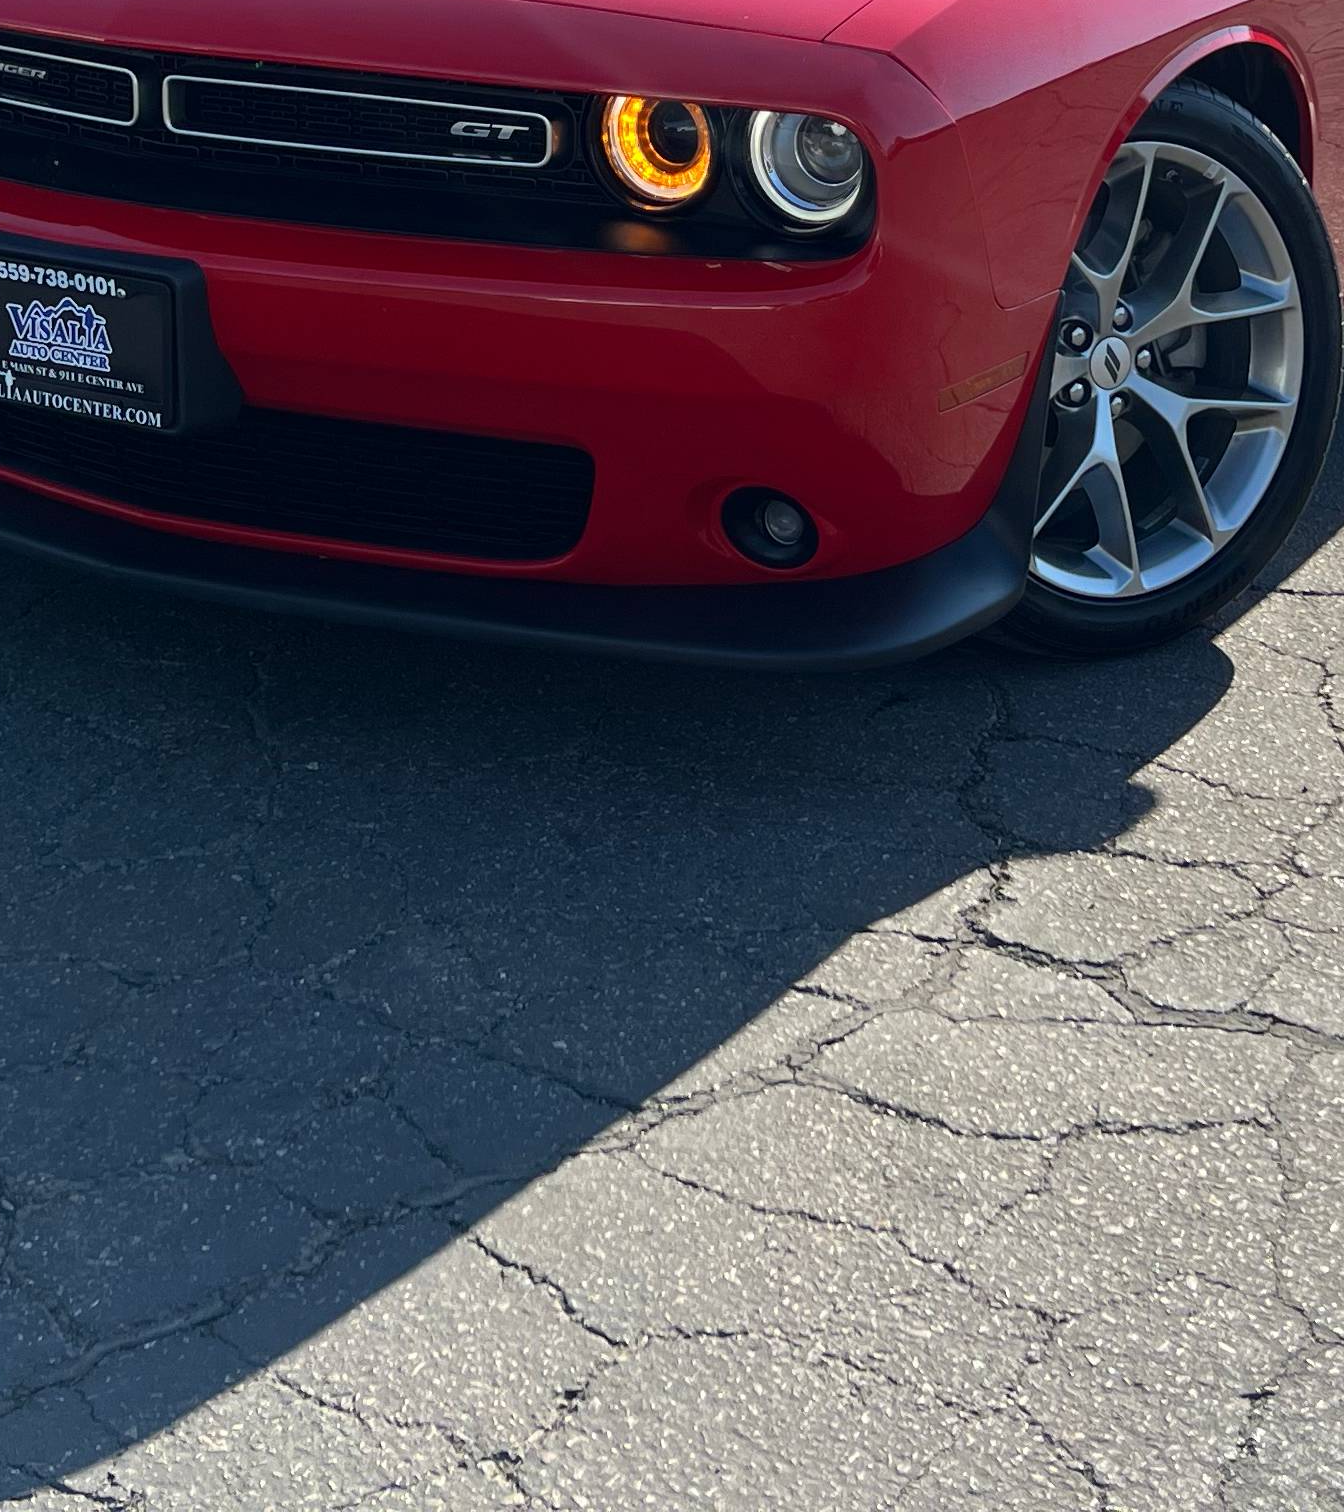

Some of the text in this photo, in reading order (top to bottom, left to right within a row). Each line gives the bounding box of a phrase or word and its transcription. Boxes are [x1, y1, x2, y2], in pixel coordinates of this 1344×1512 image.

[450, 121, 530, 140] GT
[6, 297, 113, 354] VISALIA
[10, 340, 111, 373] AUTO CENTER
[10, 361, 35, 374] MAIN
[36, 367, 47, 377] ST
[49, 368, 57, 378] &
[59, 370, 75, 382] 911
[78, 373, 84, 383] E
[86, 376, 123, 390] CENTER
[126, 382, 144, 394] AVE
